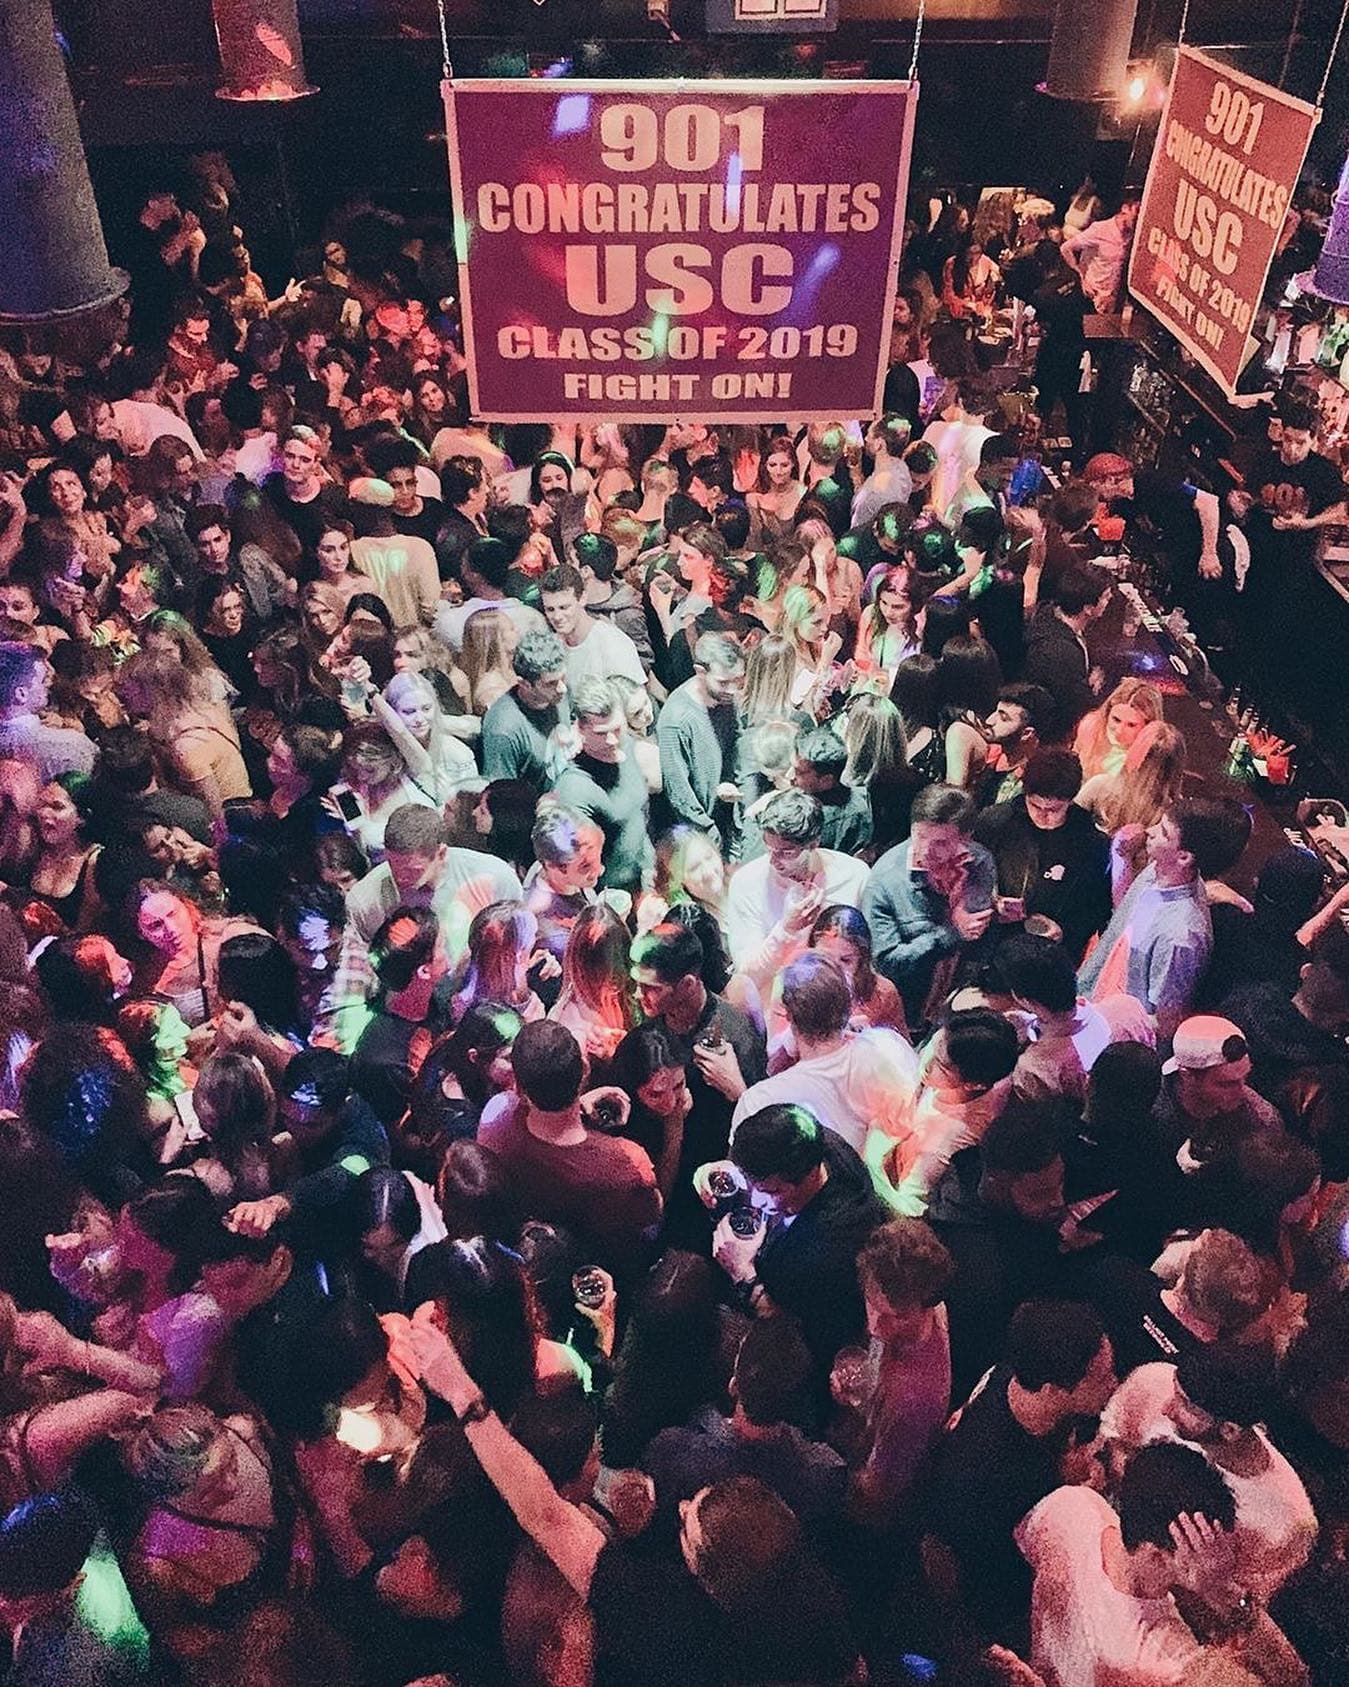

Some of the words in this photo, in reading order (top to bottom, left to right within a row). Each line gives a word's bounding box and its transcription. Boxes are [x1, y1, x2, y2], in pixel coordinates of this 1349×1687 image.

[601, 104, 765, 171] 901
[1205, 81, 1265, 155] 901
[478, 182, 881, 233] CONGRATULATES
[1166, 119, 1288, 230] CONGRATULATES
[1173, 178, 1243, 275] USC
[565, 243, 794, 317] USC
[1148, 226, 1190, 282] CLASS
[1189, 263, 1211, 298] OF
[1208, 279, 1251, 334] 2019
[1155, 274, 1196, 325] FIGHT
[1195, 310, 1225, 351] ON!
[497, 325, 653, 361] CLASS
[667, 326, 727, 360] OF
[736, 324, 858, 360] 2019
[563, 373, 700, 401] FIGHT
[711, 373, 793, 399] ON!
